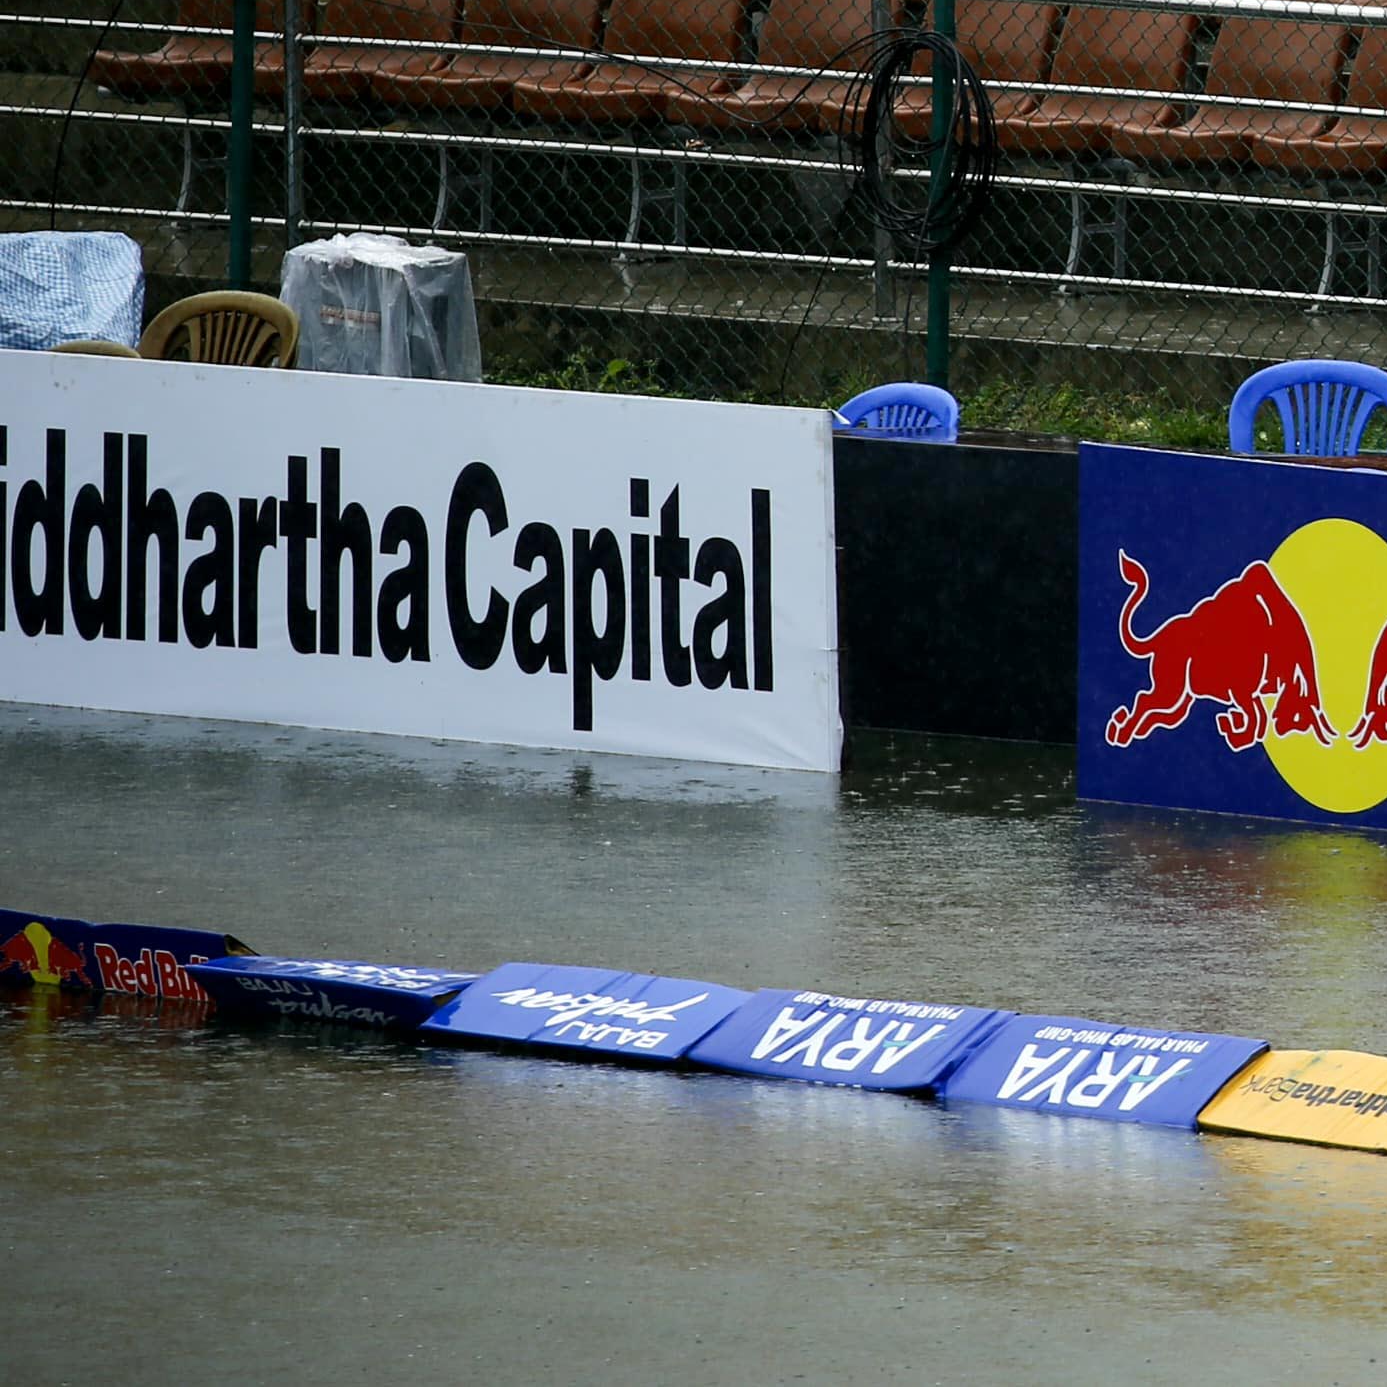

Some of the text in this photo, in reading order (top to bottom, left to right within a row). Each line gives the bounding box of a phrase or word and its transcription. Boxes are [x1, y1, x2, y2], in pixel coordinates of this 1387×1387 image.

[446, 460, 774, 731] Capital
[94, 942, 158, 997] Red
[489, 987, 709, 1027] pulsar
[561, 1019, 670, 1050] BAJAJ
[749, 1006, 948, 1074] ARYA
[996, 1043, 1193, 1110] ARYA
